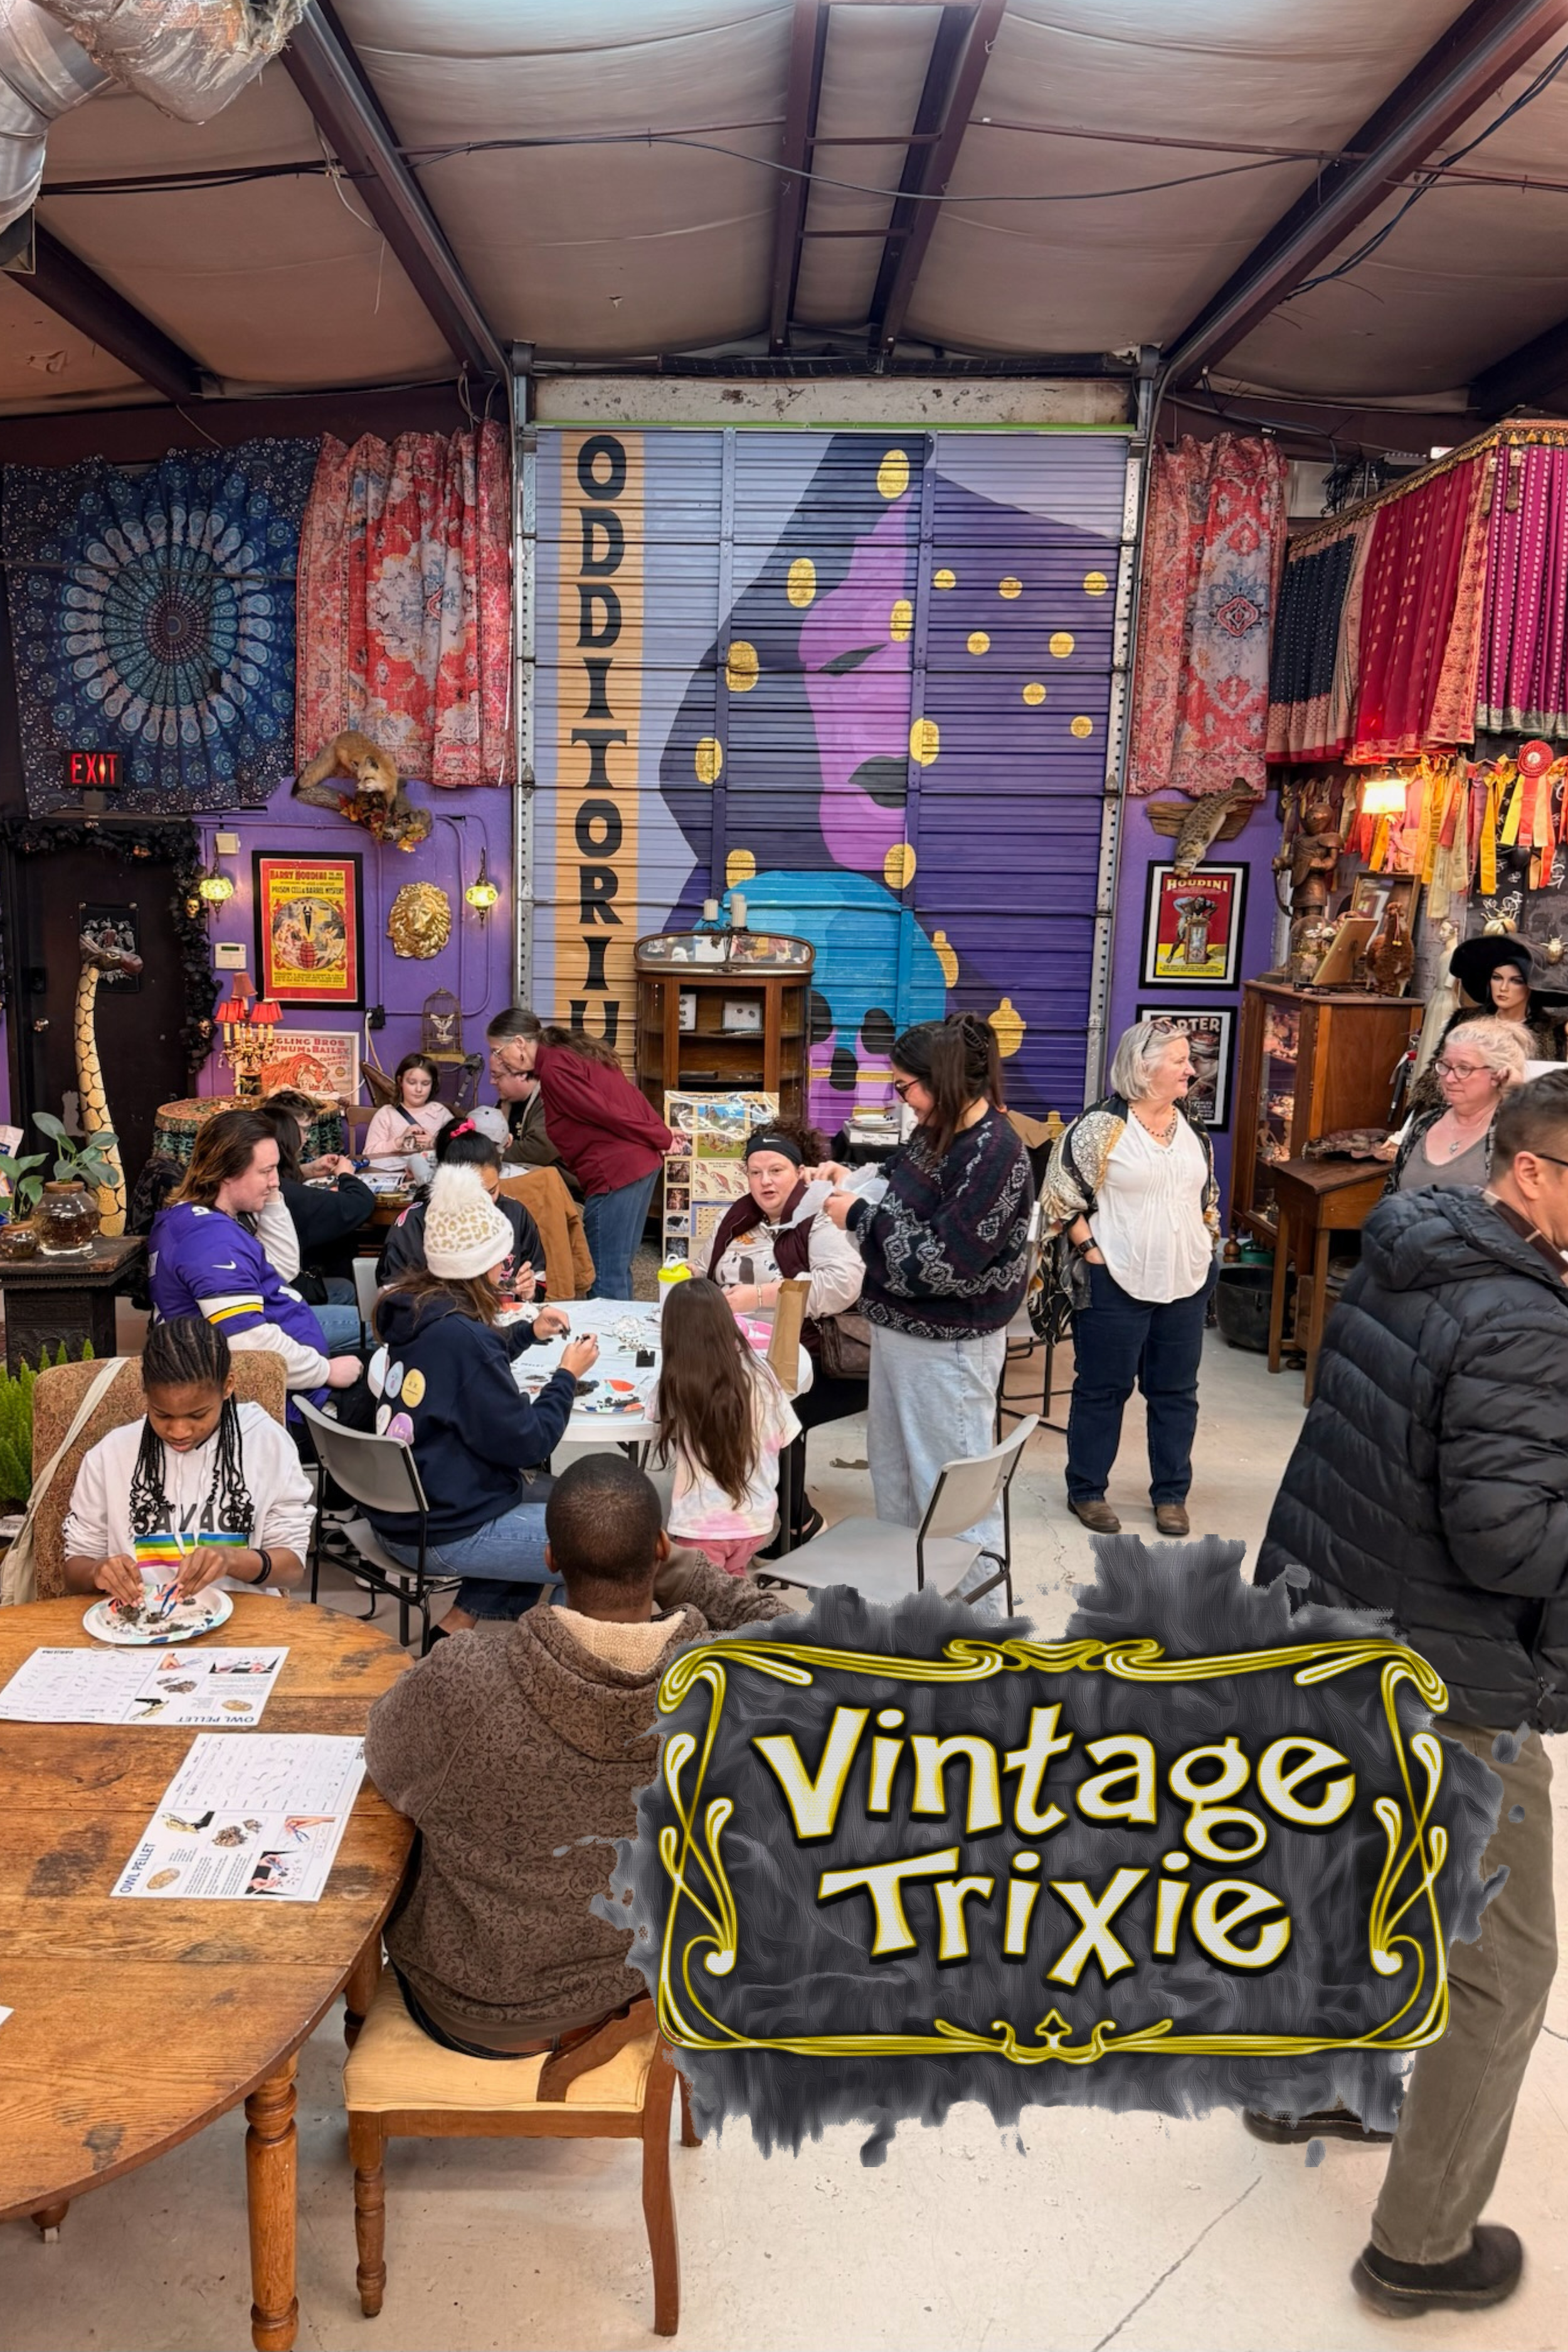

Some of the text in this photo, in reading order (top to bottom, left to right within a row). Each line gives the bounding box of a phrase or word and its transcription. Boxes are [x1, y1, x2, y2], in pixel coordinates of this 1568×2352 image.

[569, 434, 627, 1049] ODDITORIU
[71, 753, 118, 784] EXIT
[1167, 879, 1229, 892] HOUDINI
[1160, 1016, 1221, 1032] RTER
[312, 1046, 349, 1054] BAILEY
[119, 1843, 156, 1893] OWL PELLET
